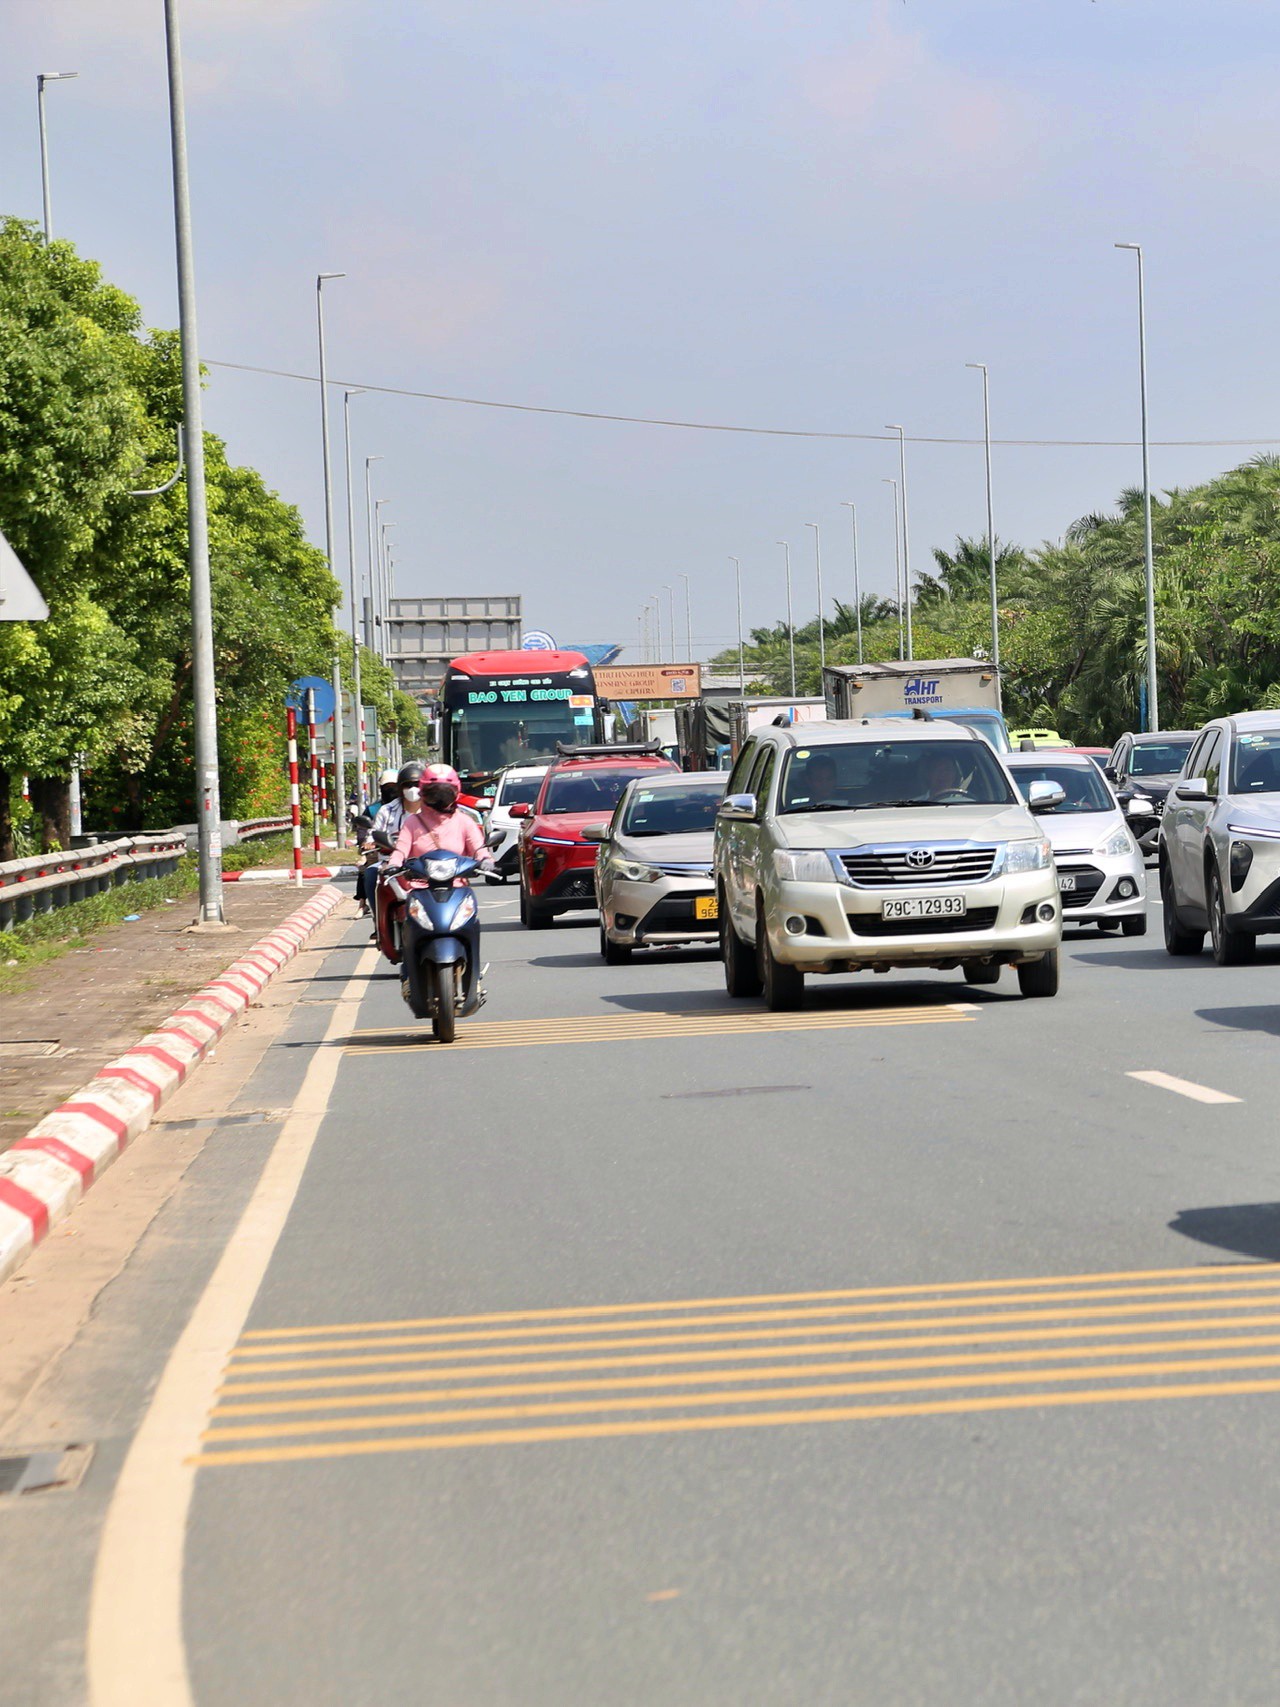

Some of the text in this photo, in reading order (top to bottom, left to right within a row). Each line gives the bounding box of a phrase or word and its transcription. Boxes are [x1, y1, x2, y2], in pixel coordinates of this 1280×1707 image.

[468, 688, 573, 704] BAO YEN GROUP
[904, 695, 943, 705] TRANSPORT
